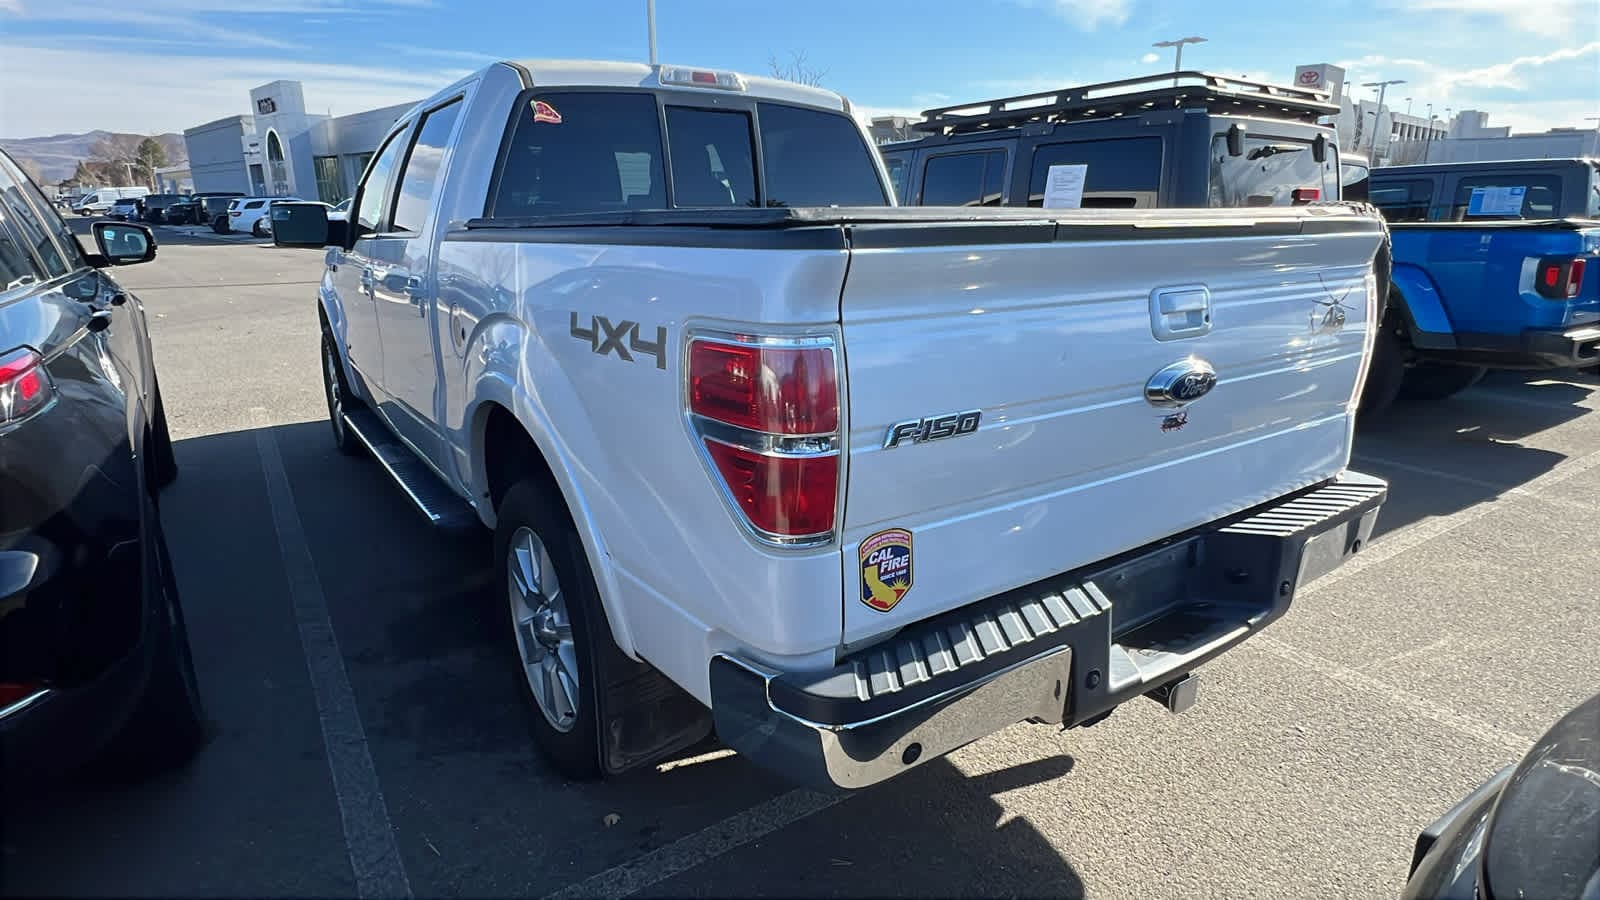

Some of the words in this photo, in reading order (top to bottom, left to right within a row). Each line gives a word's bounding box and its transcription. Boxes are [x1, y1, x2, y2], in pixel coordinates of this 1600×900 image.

[1181, 374, 1210, 397] Ford
[882, 408, 982, 450] F-150
[868, 547, 894, 565] CAL
[880, 554, 909, 573] FIRE
